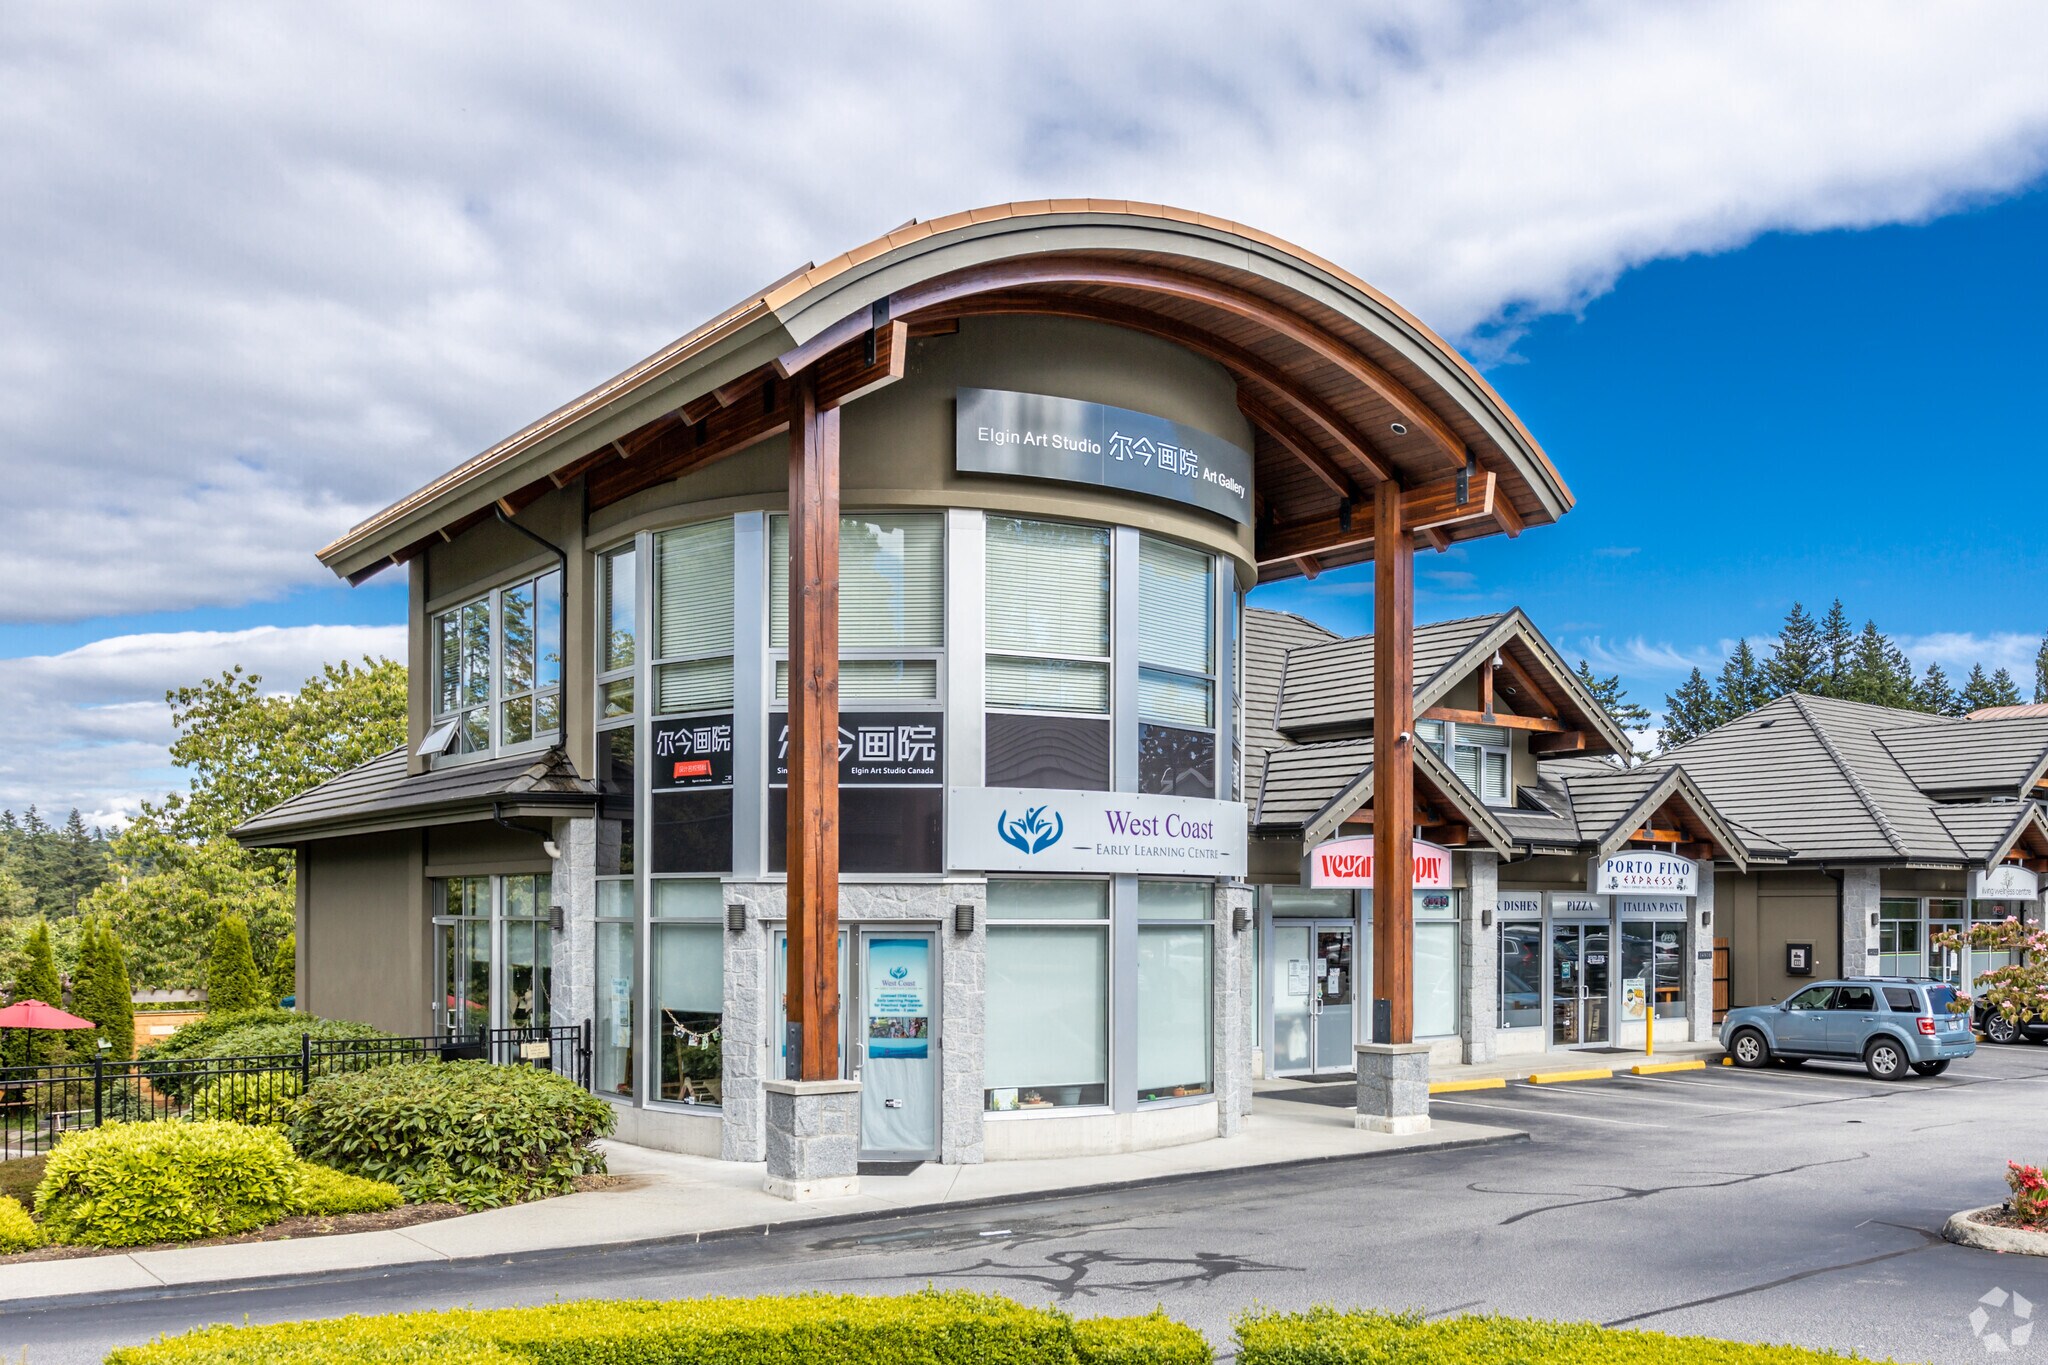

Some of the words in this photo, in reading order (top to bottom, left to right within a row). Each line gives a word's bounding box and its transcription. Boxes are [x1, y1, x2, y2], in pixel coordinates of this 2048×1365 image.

[978, 427, 1020, 446] Elgin
[1023, 431, 1048, 447] Art
[1051, 434, 1101, 455] Studio
[1108, 431, 1199, 479] 尔今画院
[1203, 467, 1218, 484] Art
[1218, 473, 1246, 499] Gallery
[656, 724, 731, 757] 尔今画院
[851, 767, 869, 776] Elgin
[883, 766, 906, 774] Studio
[907, 766, 934, 774] Canada
[1104, 810, 1160, 837] West
[1165, 813, 1214, 840] Coast
[1096, 843, 1131, 856] EARLY
[1134, 844, 1185, 858] LEARNING
[1187, 847, 1219, 859] CENTRE
[1607, 859, 1653, 875] PORTO
[1659, 862, 1690, 876] FINO
[1623, 875, 1673, 886] EXPRESS
[1504, 900, 1538, 911] DISHES
[1567, 900, 1593, 911] PIZZA
[1623, 901, 1657, 912] ITALIAN
[1659, 902, 1684, 912] PASTA
